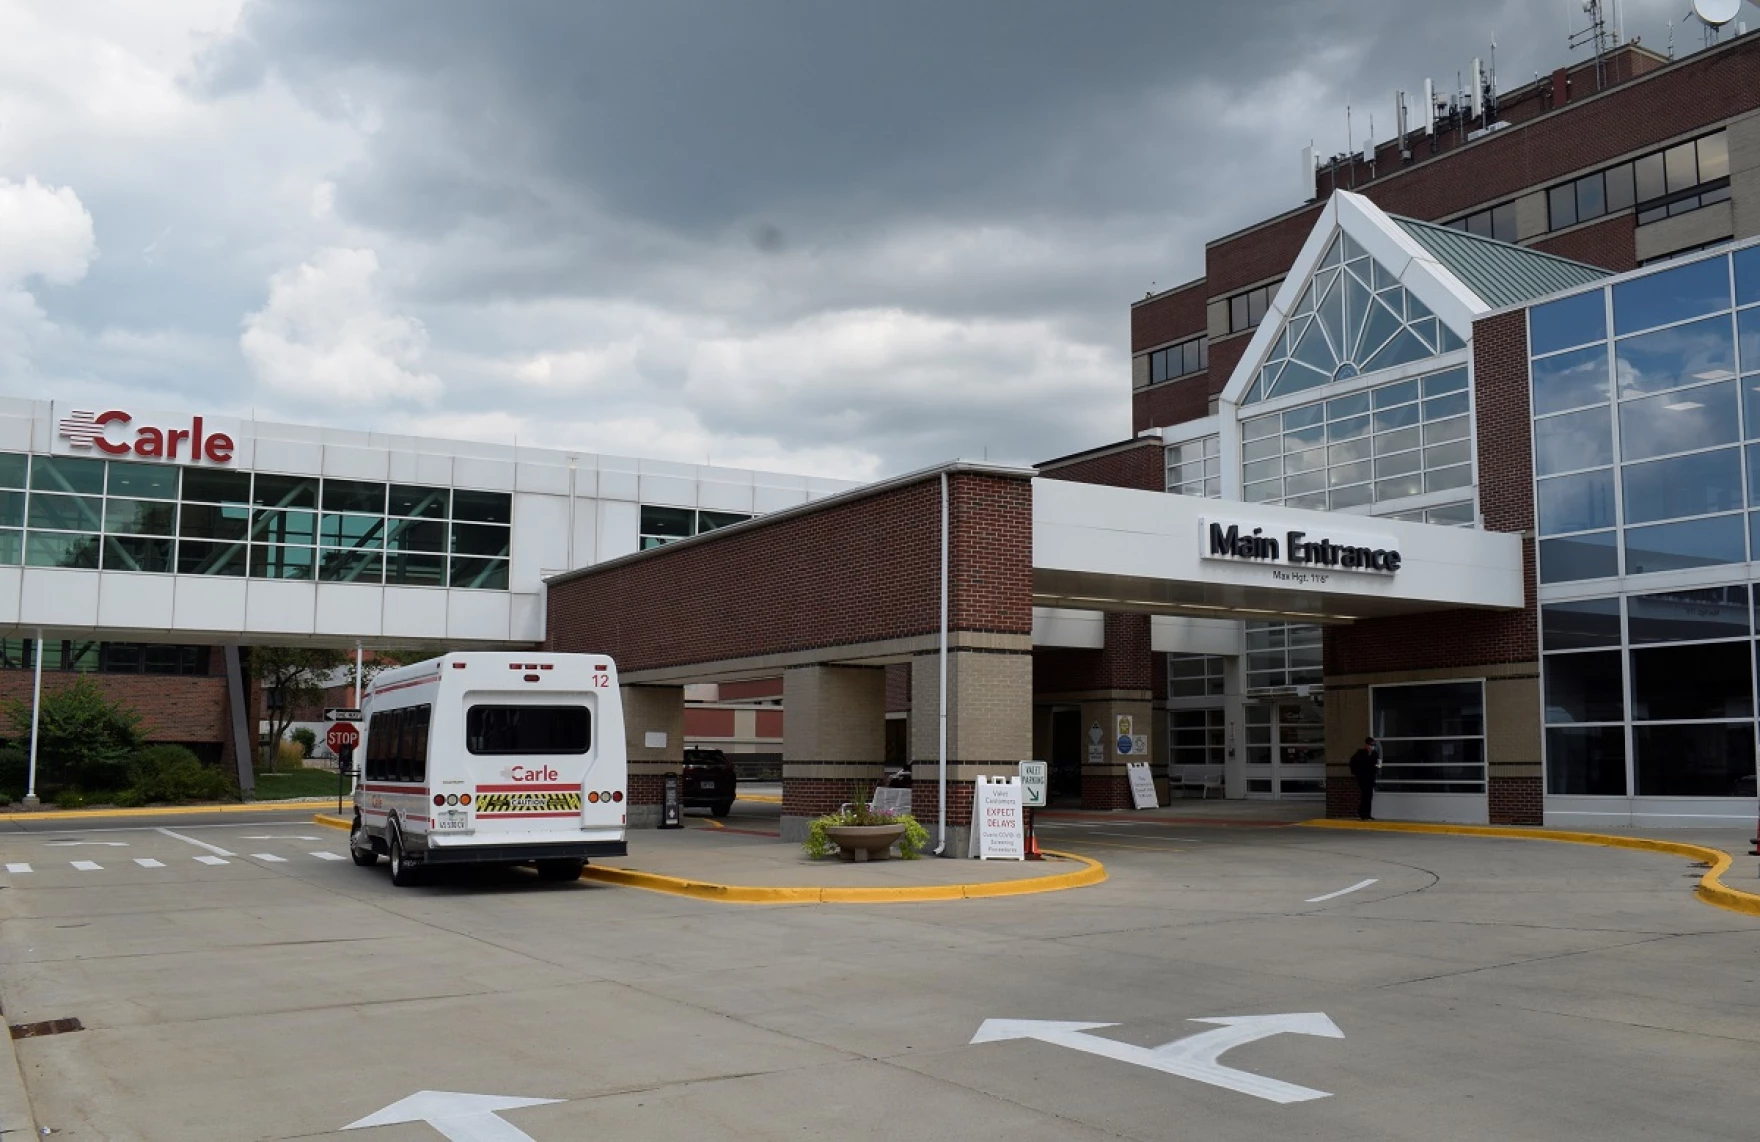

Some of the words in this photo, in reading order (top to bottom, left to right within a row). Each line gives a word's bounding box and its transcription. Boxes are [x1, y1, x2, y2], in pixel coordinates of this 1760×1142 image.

[92, 410, 234, 462] Carle
[1209, 522, 1280, 560] Main
[1286, 531, 1401, 571] Entrance
[1272, 570, 1290, 581] Max
[1291, 572, 1308, 584] Hgt.
[592, 674, 609, 688] 12
[328, 732, 357, 745] STOP
[511, 765, 559, 782] Carle
[1026, 765, 1041, 775] VALET
[1021, 776, 1044, 785] PARKING
[993, 790, 1008, 798] Valet
[511, 799, 545, 807] CAUTION
[985, 797, 1015, 805] Customers
[986, 808, 1015, 817] EXPECT
[987, 819, 1016, 828] DELAYS
